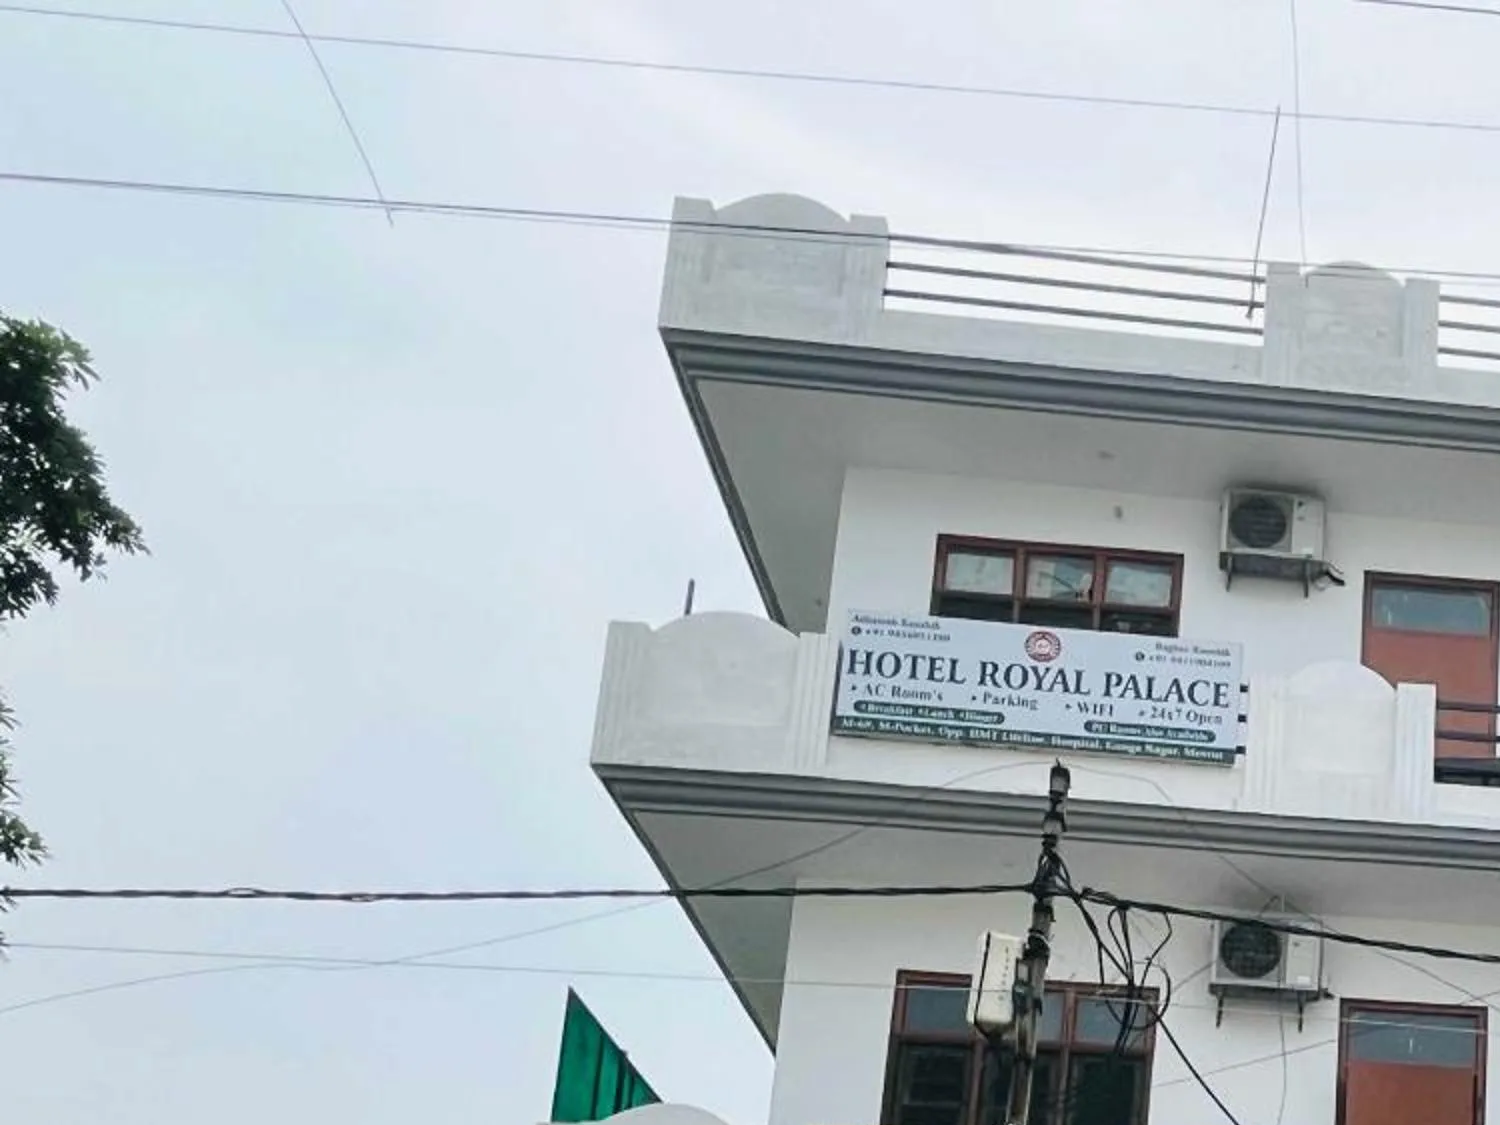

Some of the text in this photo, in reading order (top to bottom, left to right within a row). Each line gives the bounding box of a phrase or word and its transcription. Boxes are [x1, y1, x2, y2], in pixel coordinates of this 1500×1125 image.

[847, 648, 1230, 709] HOTEL ROYAL PALACE
[864, 683, 1223, 726] AC Room's Parking WIFI 24x7 Open
